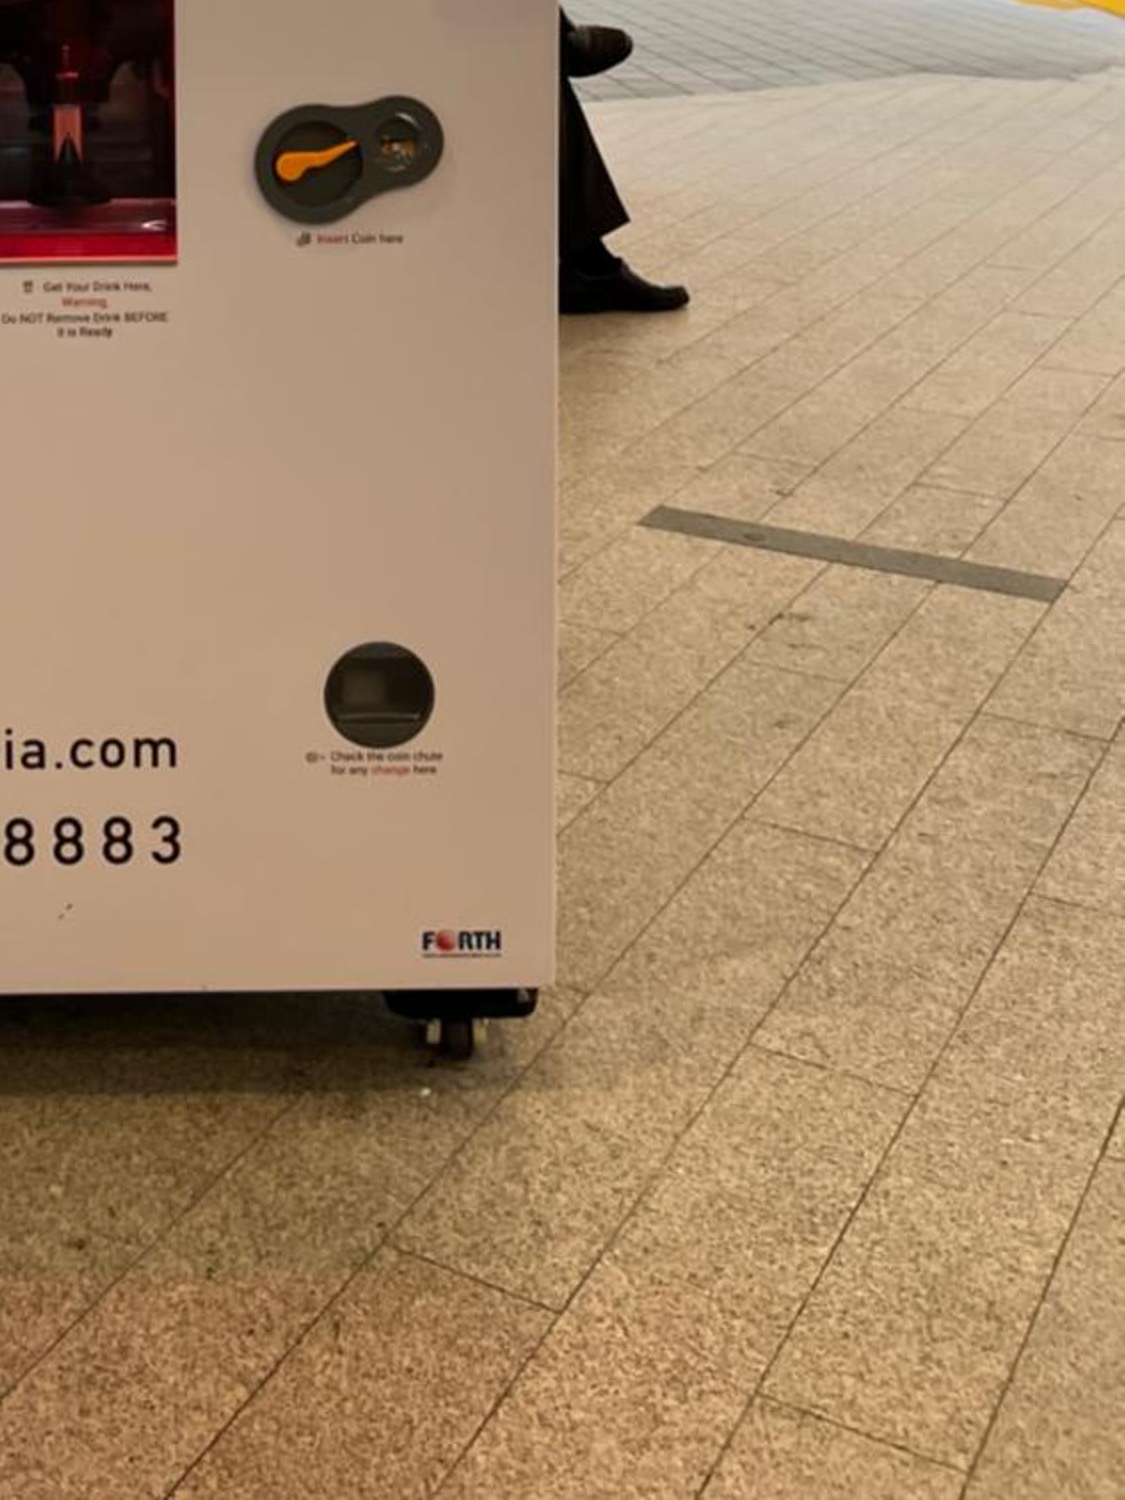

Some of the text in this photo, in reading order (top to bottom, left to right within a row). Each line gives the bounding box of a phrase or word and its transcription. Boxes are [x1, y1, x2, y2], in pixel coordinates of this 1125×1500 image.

[316, 233, 404, 244] Insert Coin here
[43, 281, 63, 293] Get
[66, 281, 90, 292] Your
[92, 280, 121, 292] Drink
[1, 311, 168, 324] Do NOT Remove Drink BEFORE
[80, 326, 113, 339] Ready
[330, 749, 444, 762] Check the coin chute
[330, 763, 437, 777] for any change here
[2, 815, 182, 869] 8883
[421, 929, 502, 951] FORTH
